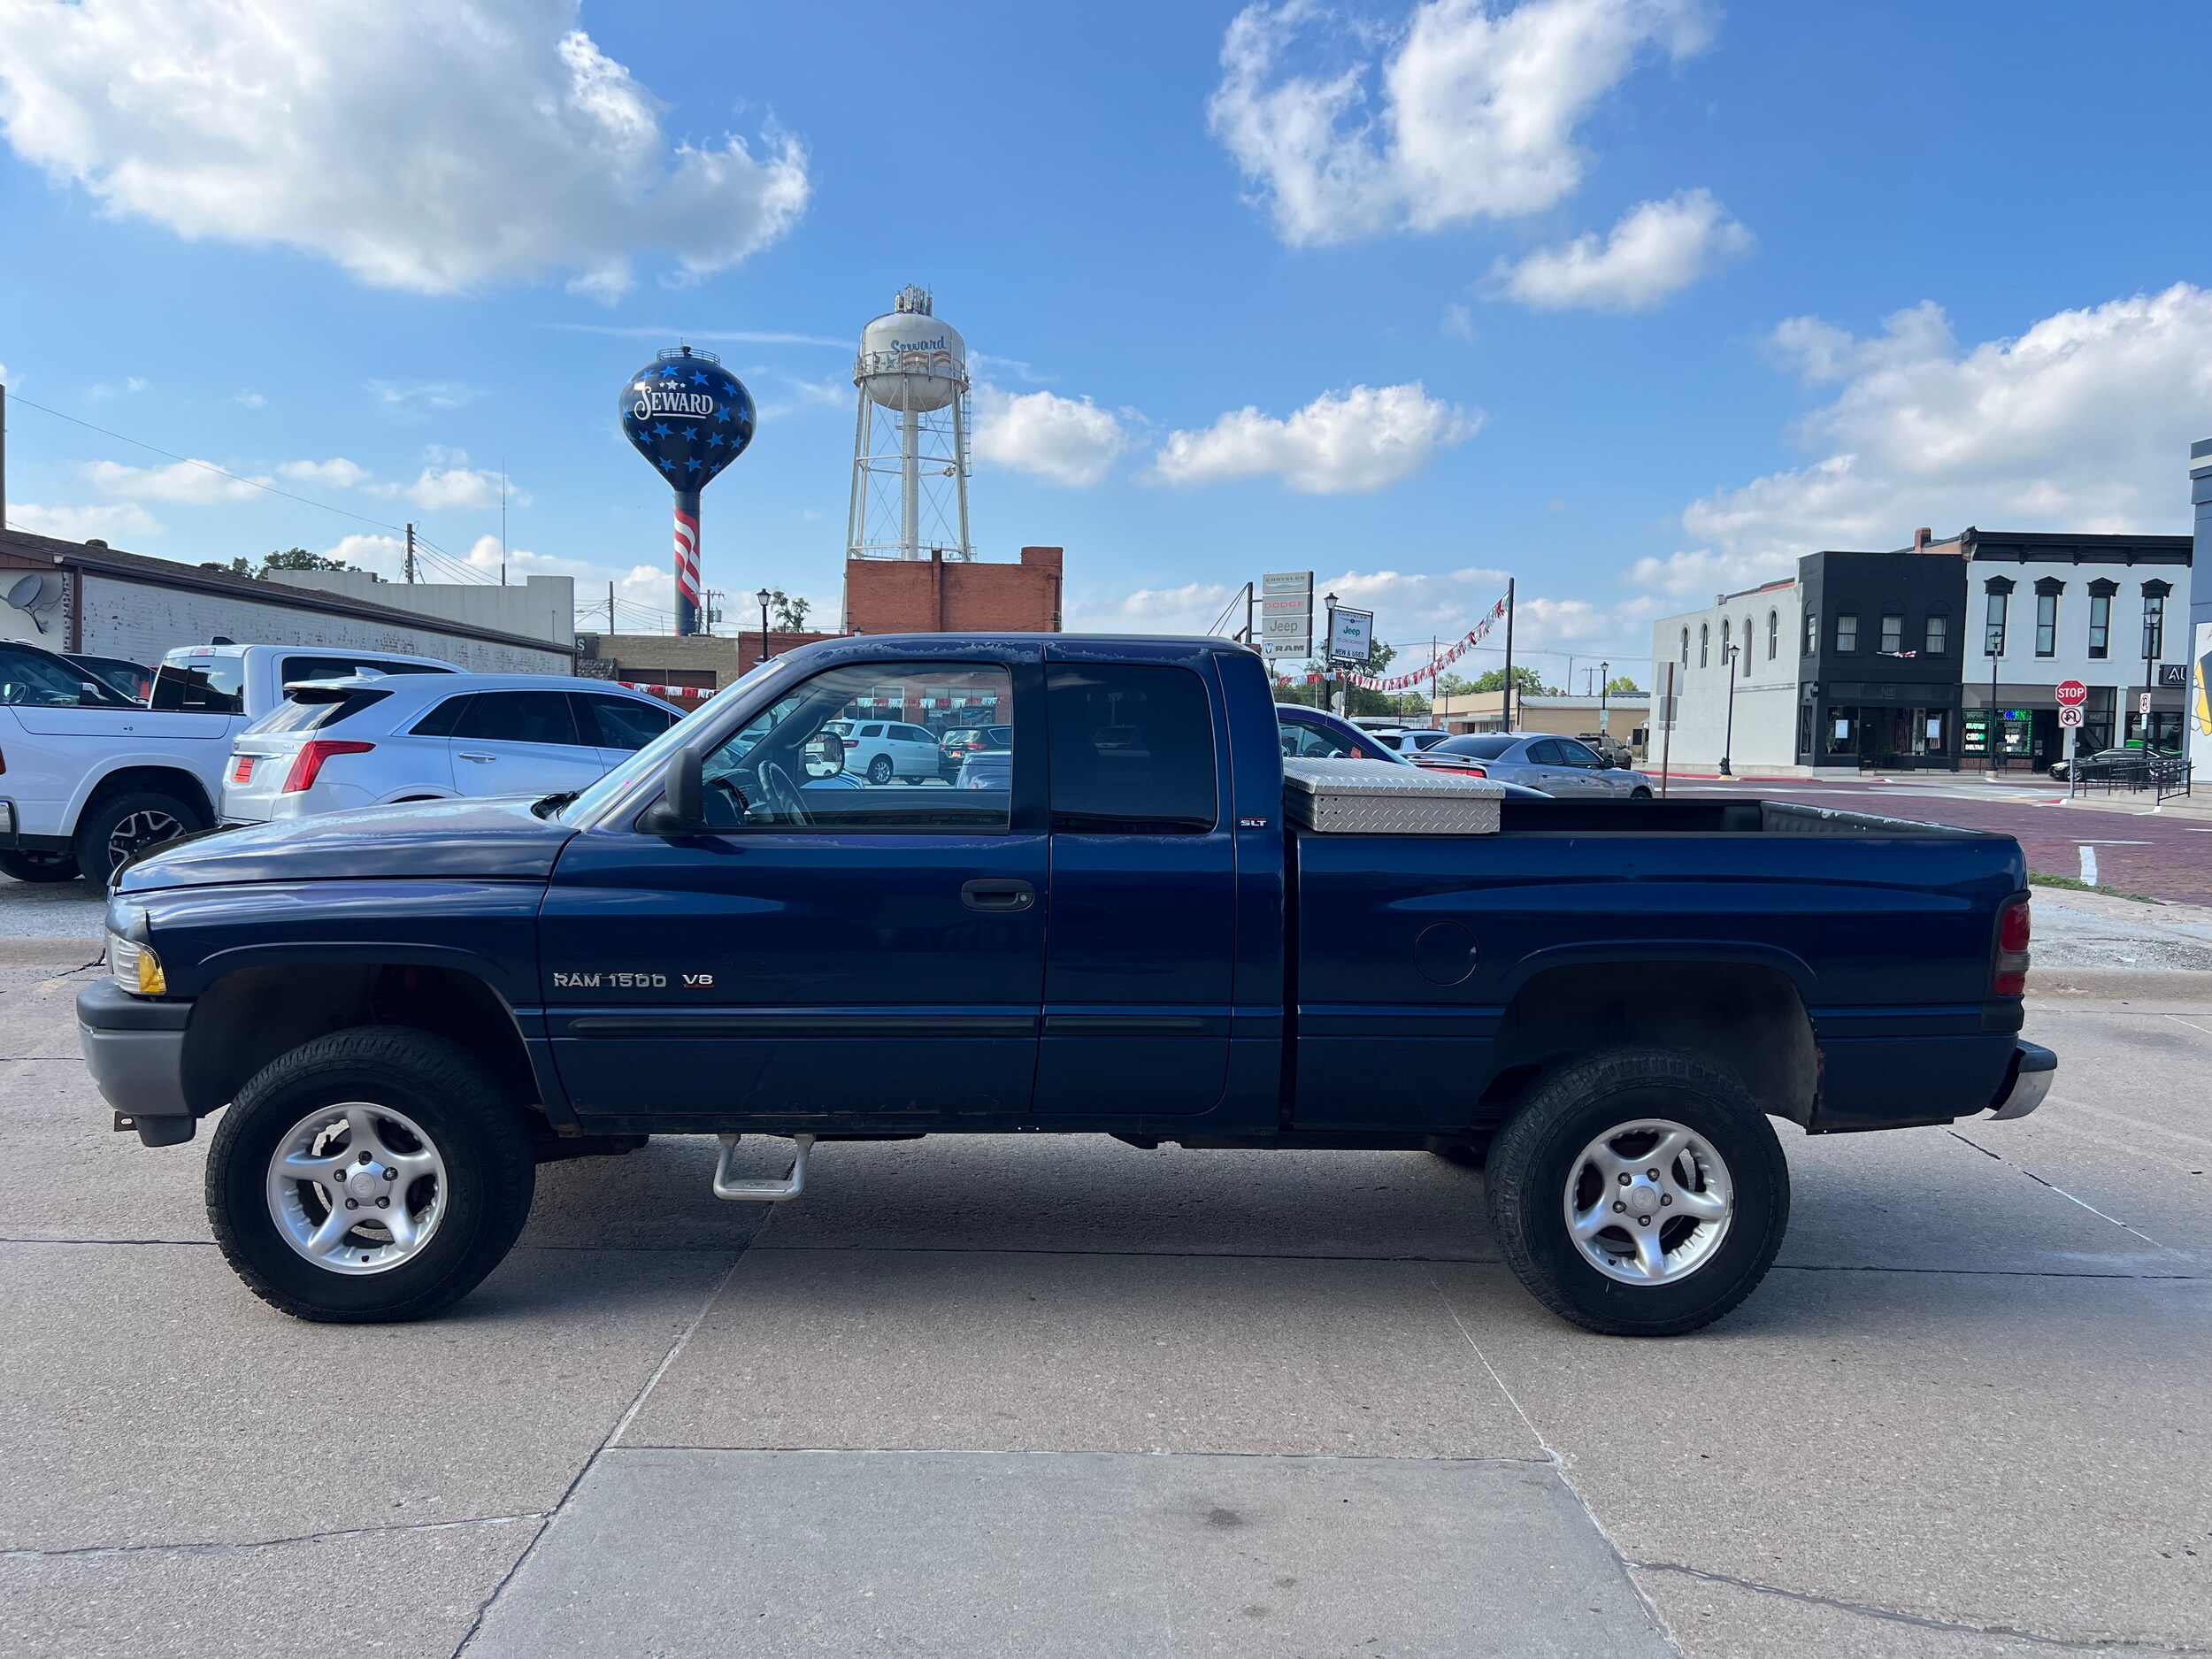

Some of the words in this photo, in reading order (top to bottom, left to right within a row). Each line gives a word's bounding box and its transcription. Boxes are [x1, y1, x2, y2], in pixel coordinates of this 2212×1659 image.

[891, 335, 947, 355] Seward
[1270, 620, 1298, 634] Jeep
[1343, 626, 1361, 637] Jeep
[2057, 687, 2085, 698] STOP
[2003, 710, 2027, 719] OPEN
[555, 973, 600, 987] RAM
[608, 974, 666, 987] 1500
[682, 974, 713, 985] V8
